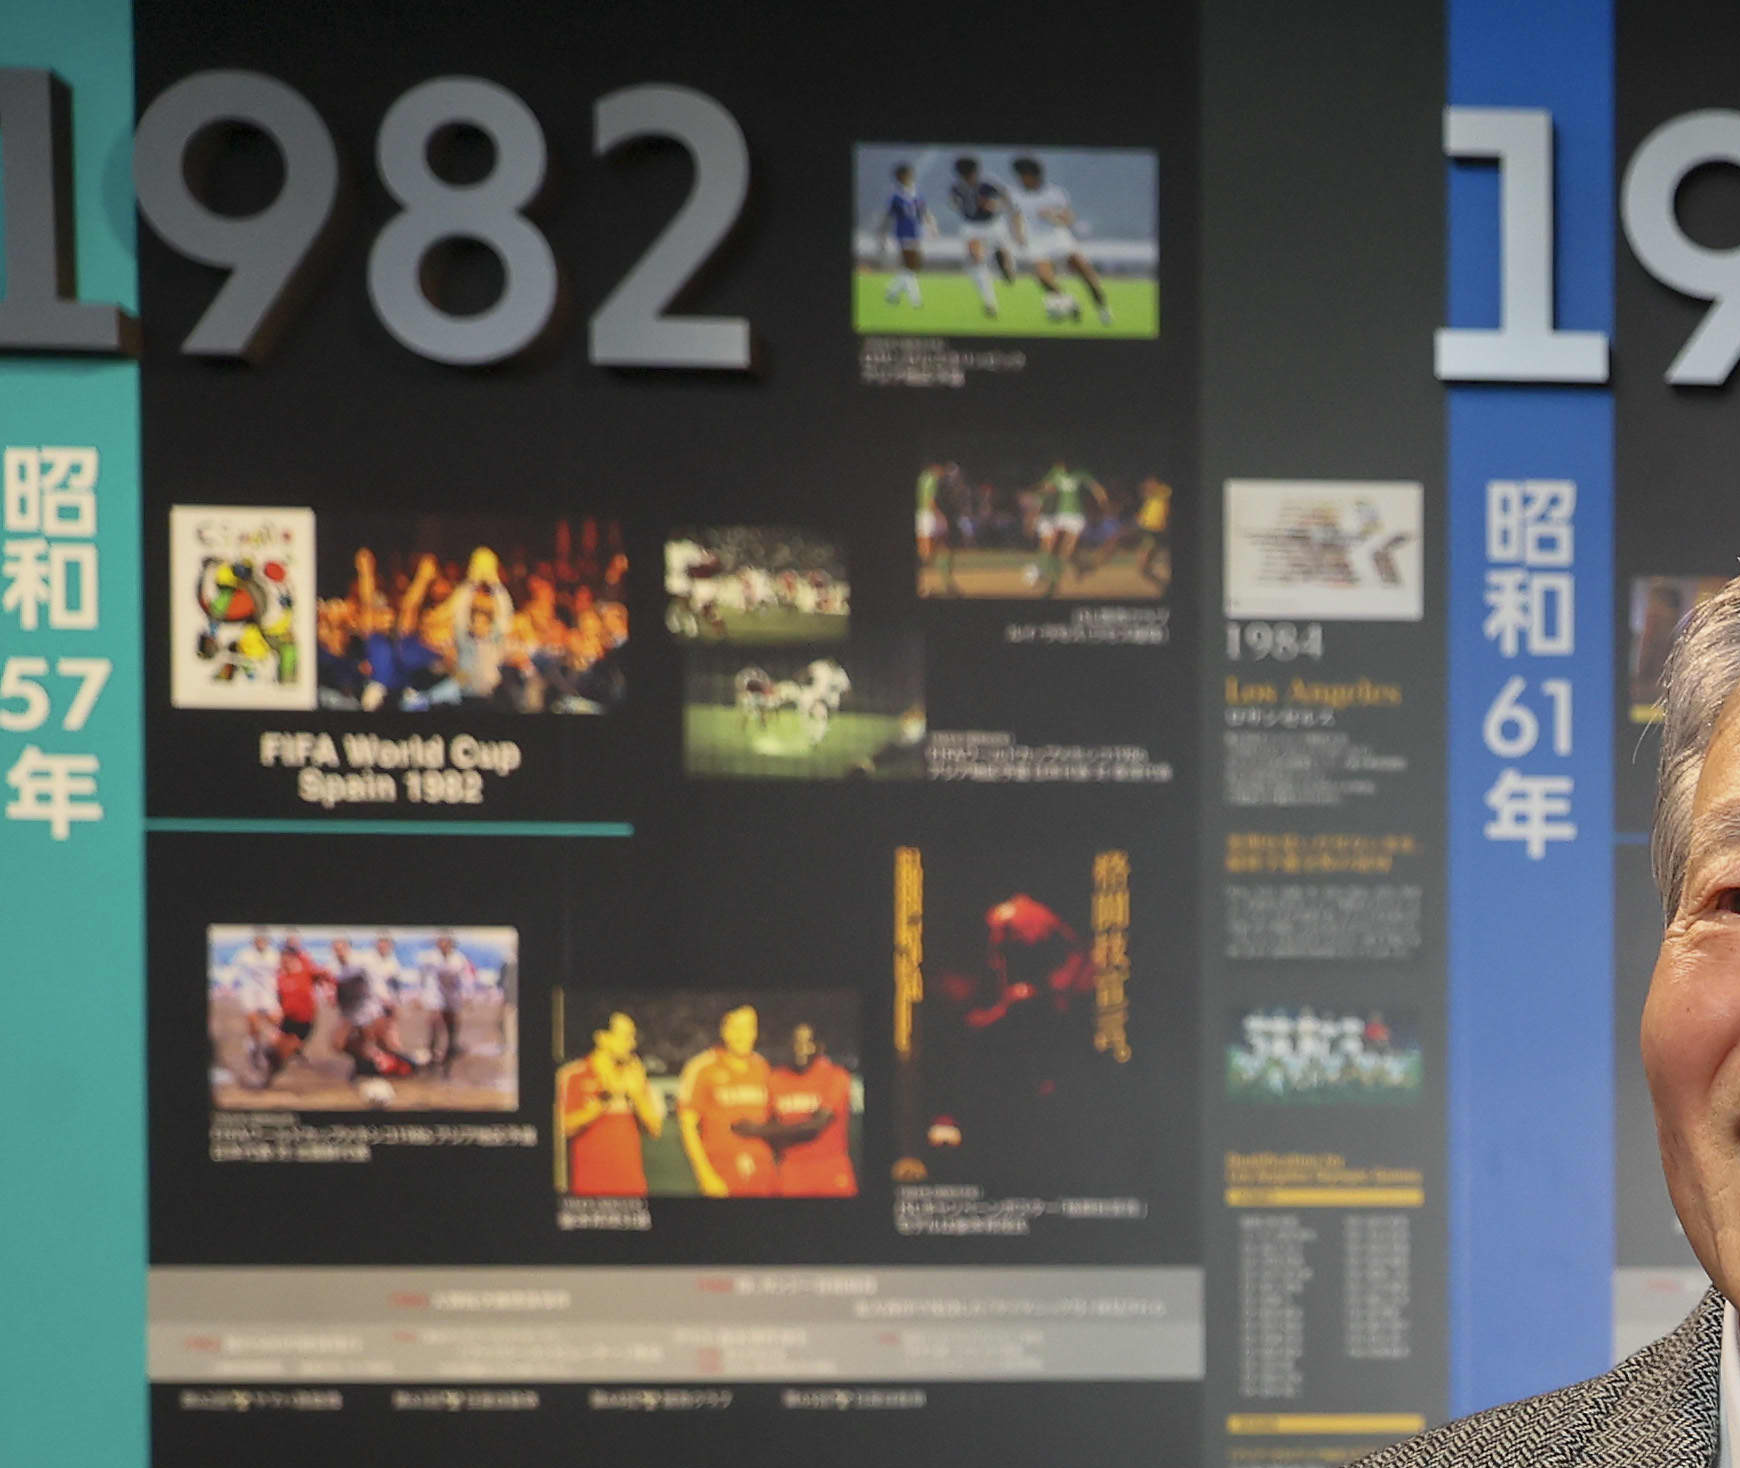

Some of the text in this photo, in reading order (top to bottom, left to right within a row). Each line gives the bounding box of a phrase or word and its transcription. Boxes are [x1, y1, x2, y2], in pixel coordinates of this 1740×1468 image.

[0, 67, 753, 370] 1982
[1, 446, 111, 841] 昭和57年
[261, 732, 521, 777] FIFA World Cup
[297, 768, 484, 807] Spain 1982
[1483, 479, 1577, 859] 昭和61年
